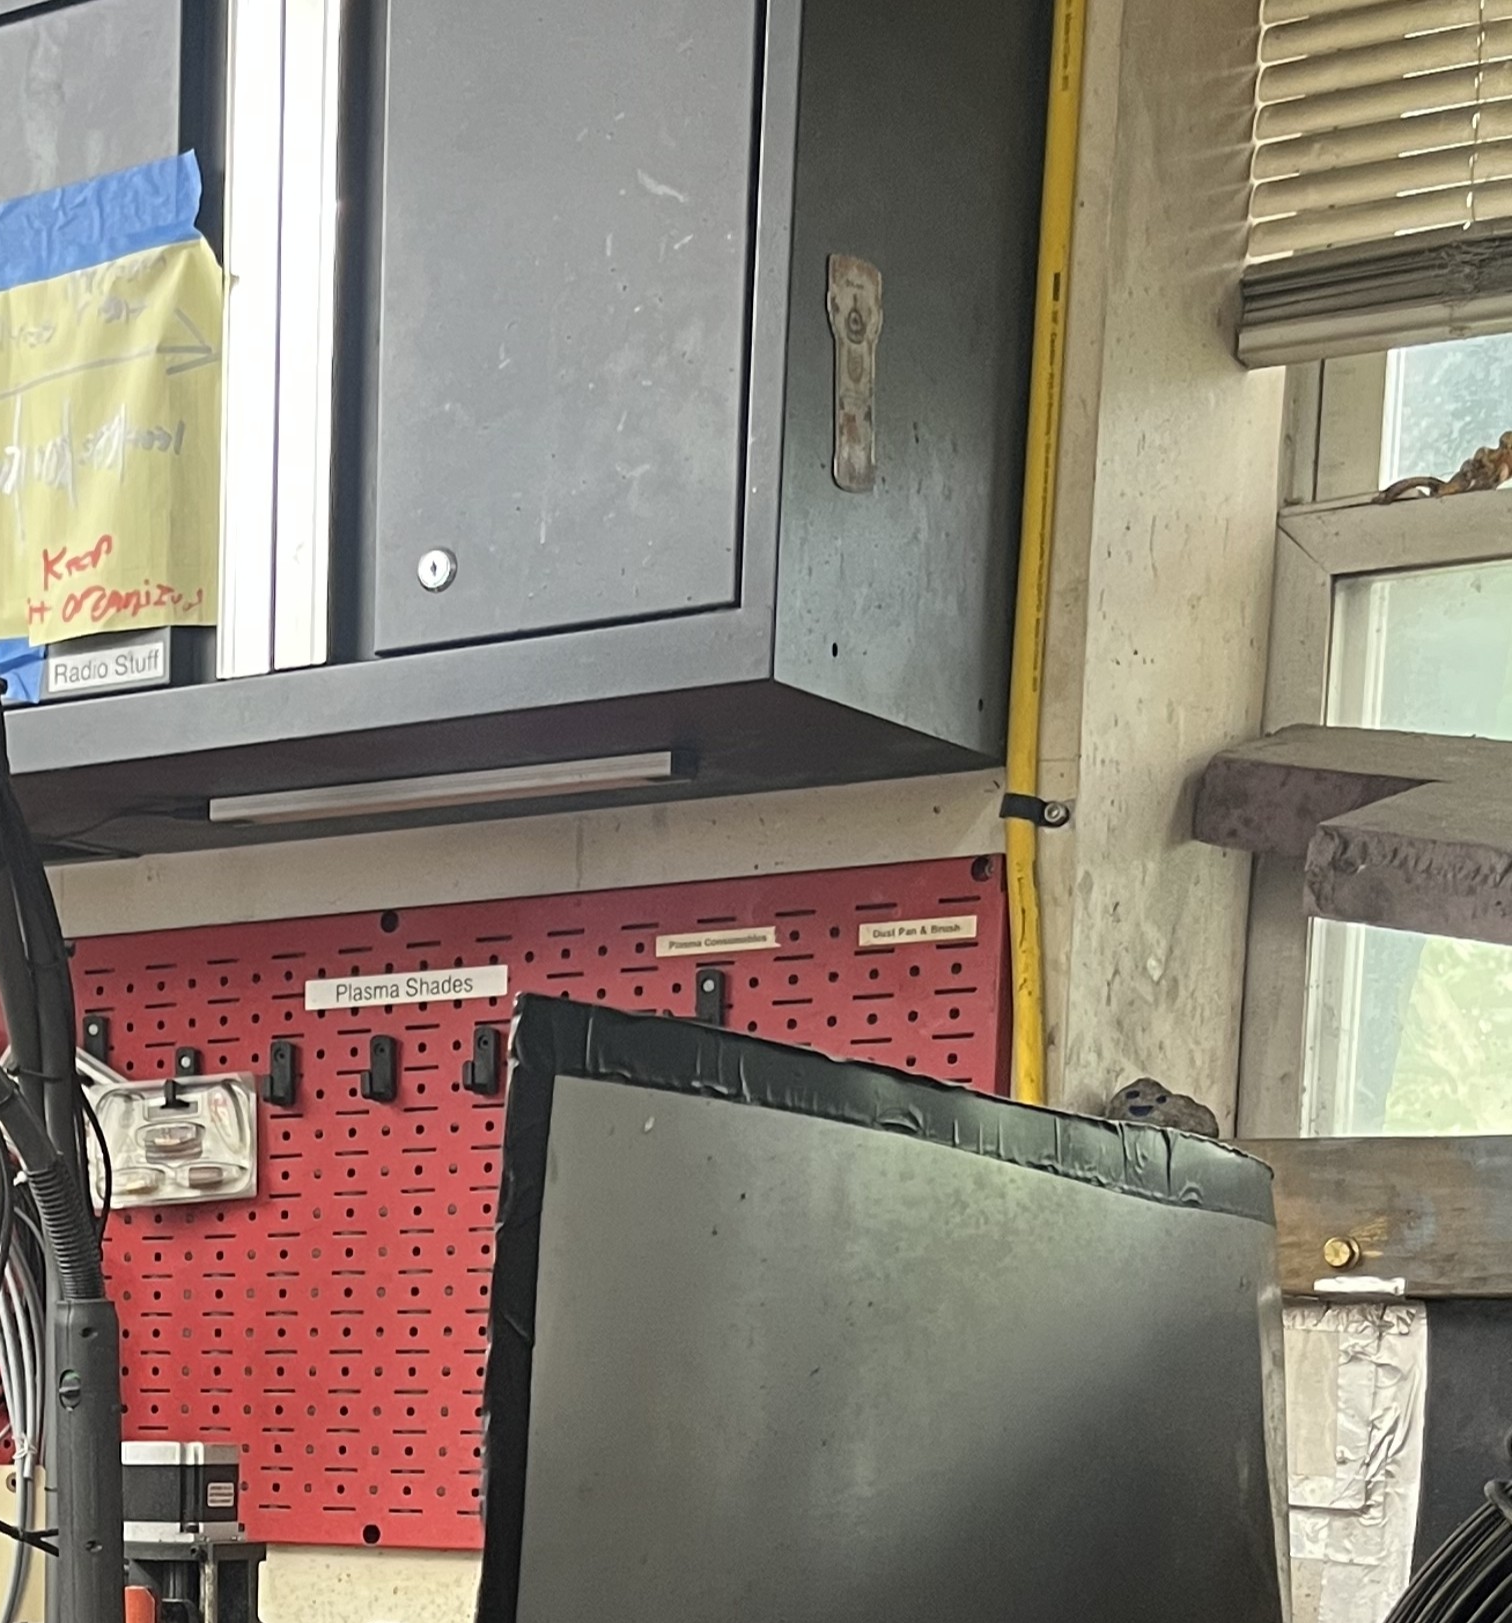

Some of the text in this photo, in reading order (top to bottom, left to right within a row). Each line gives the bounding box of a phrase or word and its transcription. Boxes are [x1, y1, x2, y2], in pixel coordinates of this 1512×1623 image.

[54, 649, 160, 686] Radio Stuff
[872, 924, 961, 939] Dust Pan & Brush
[335, 975, 474, 1004] Plasma Shades
